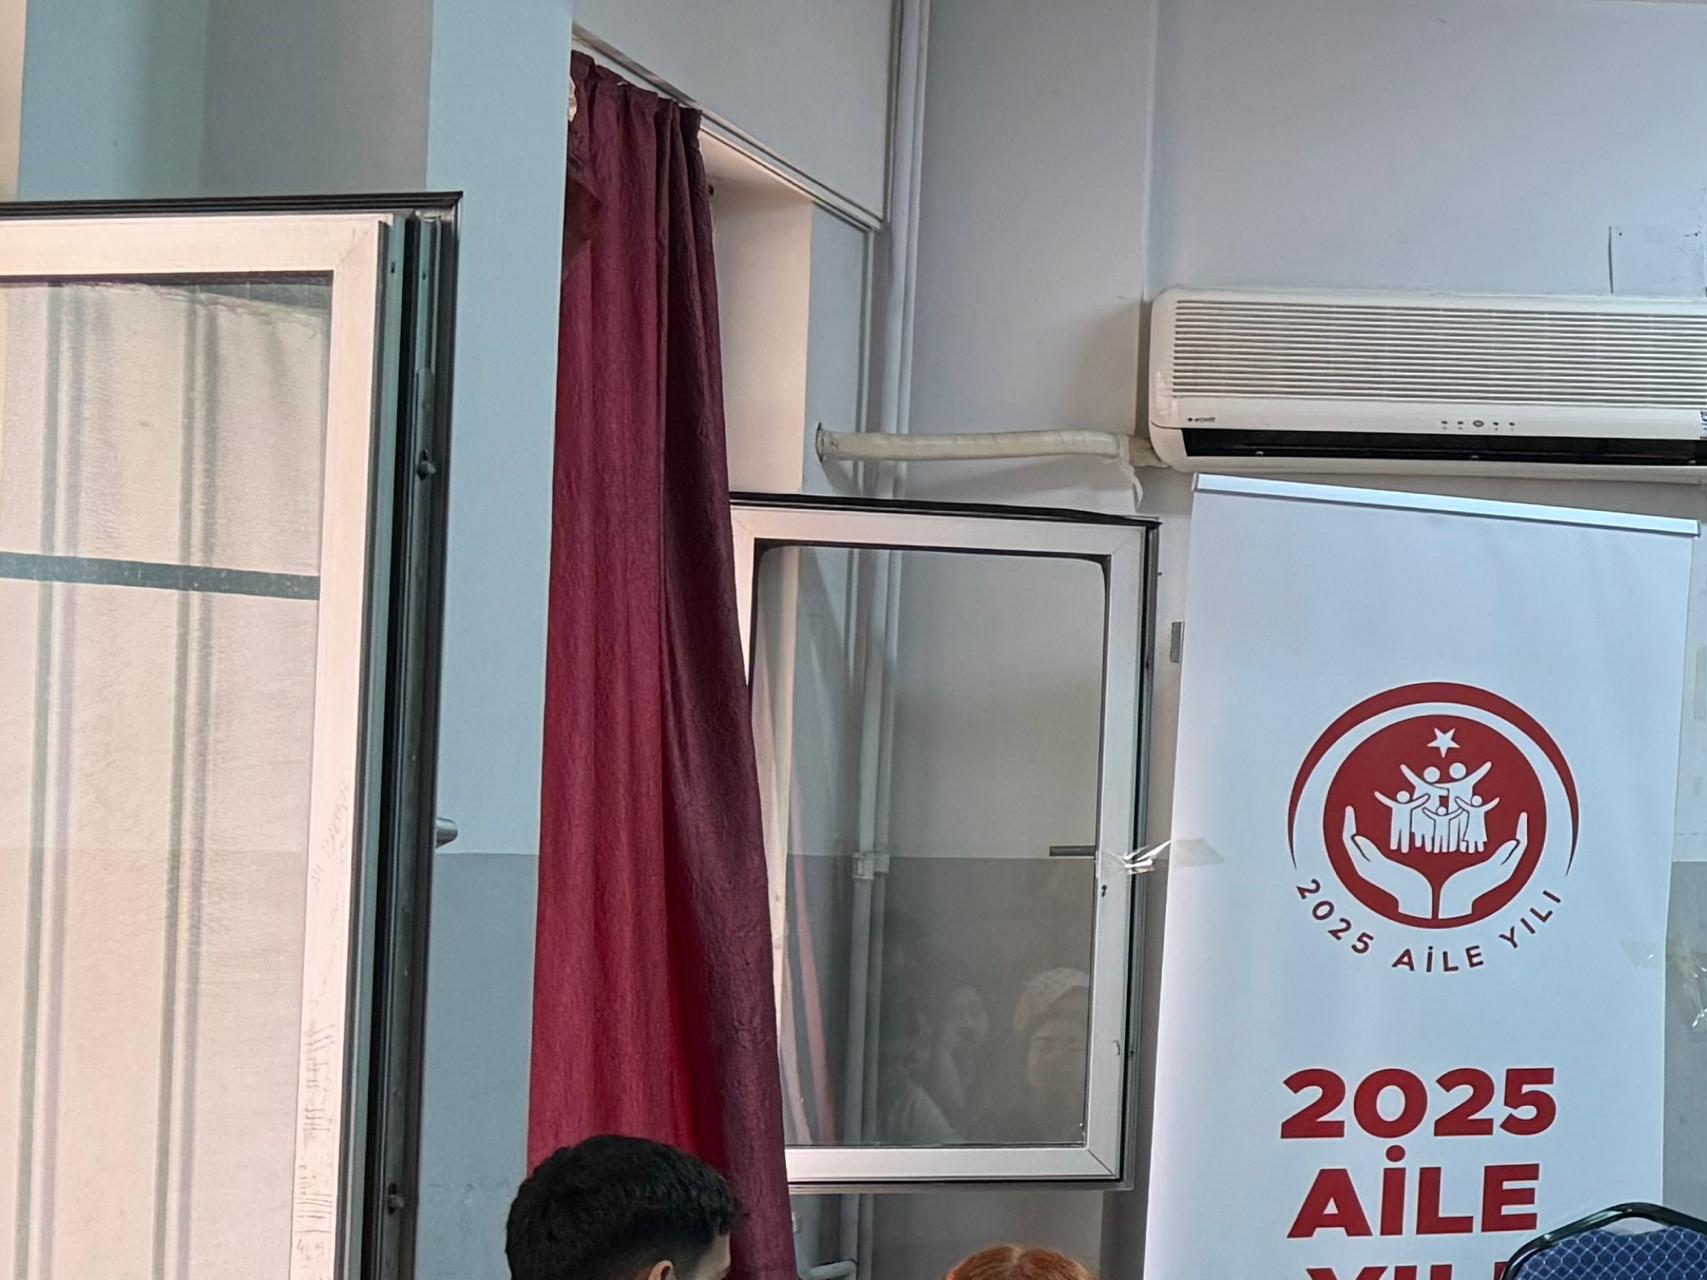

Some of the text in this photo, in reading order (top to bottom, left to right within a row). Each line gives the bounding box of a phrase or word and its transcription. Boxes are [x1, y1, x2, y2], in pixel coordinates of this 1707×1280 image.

[1296, 878, 1562, 973] 2025 AİLE YILI
[1280, 1067, 1557, 1140] 2025
[1286, 1144, 1541, 1239] AİLE
